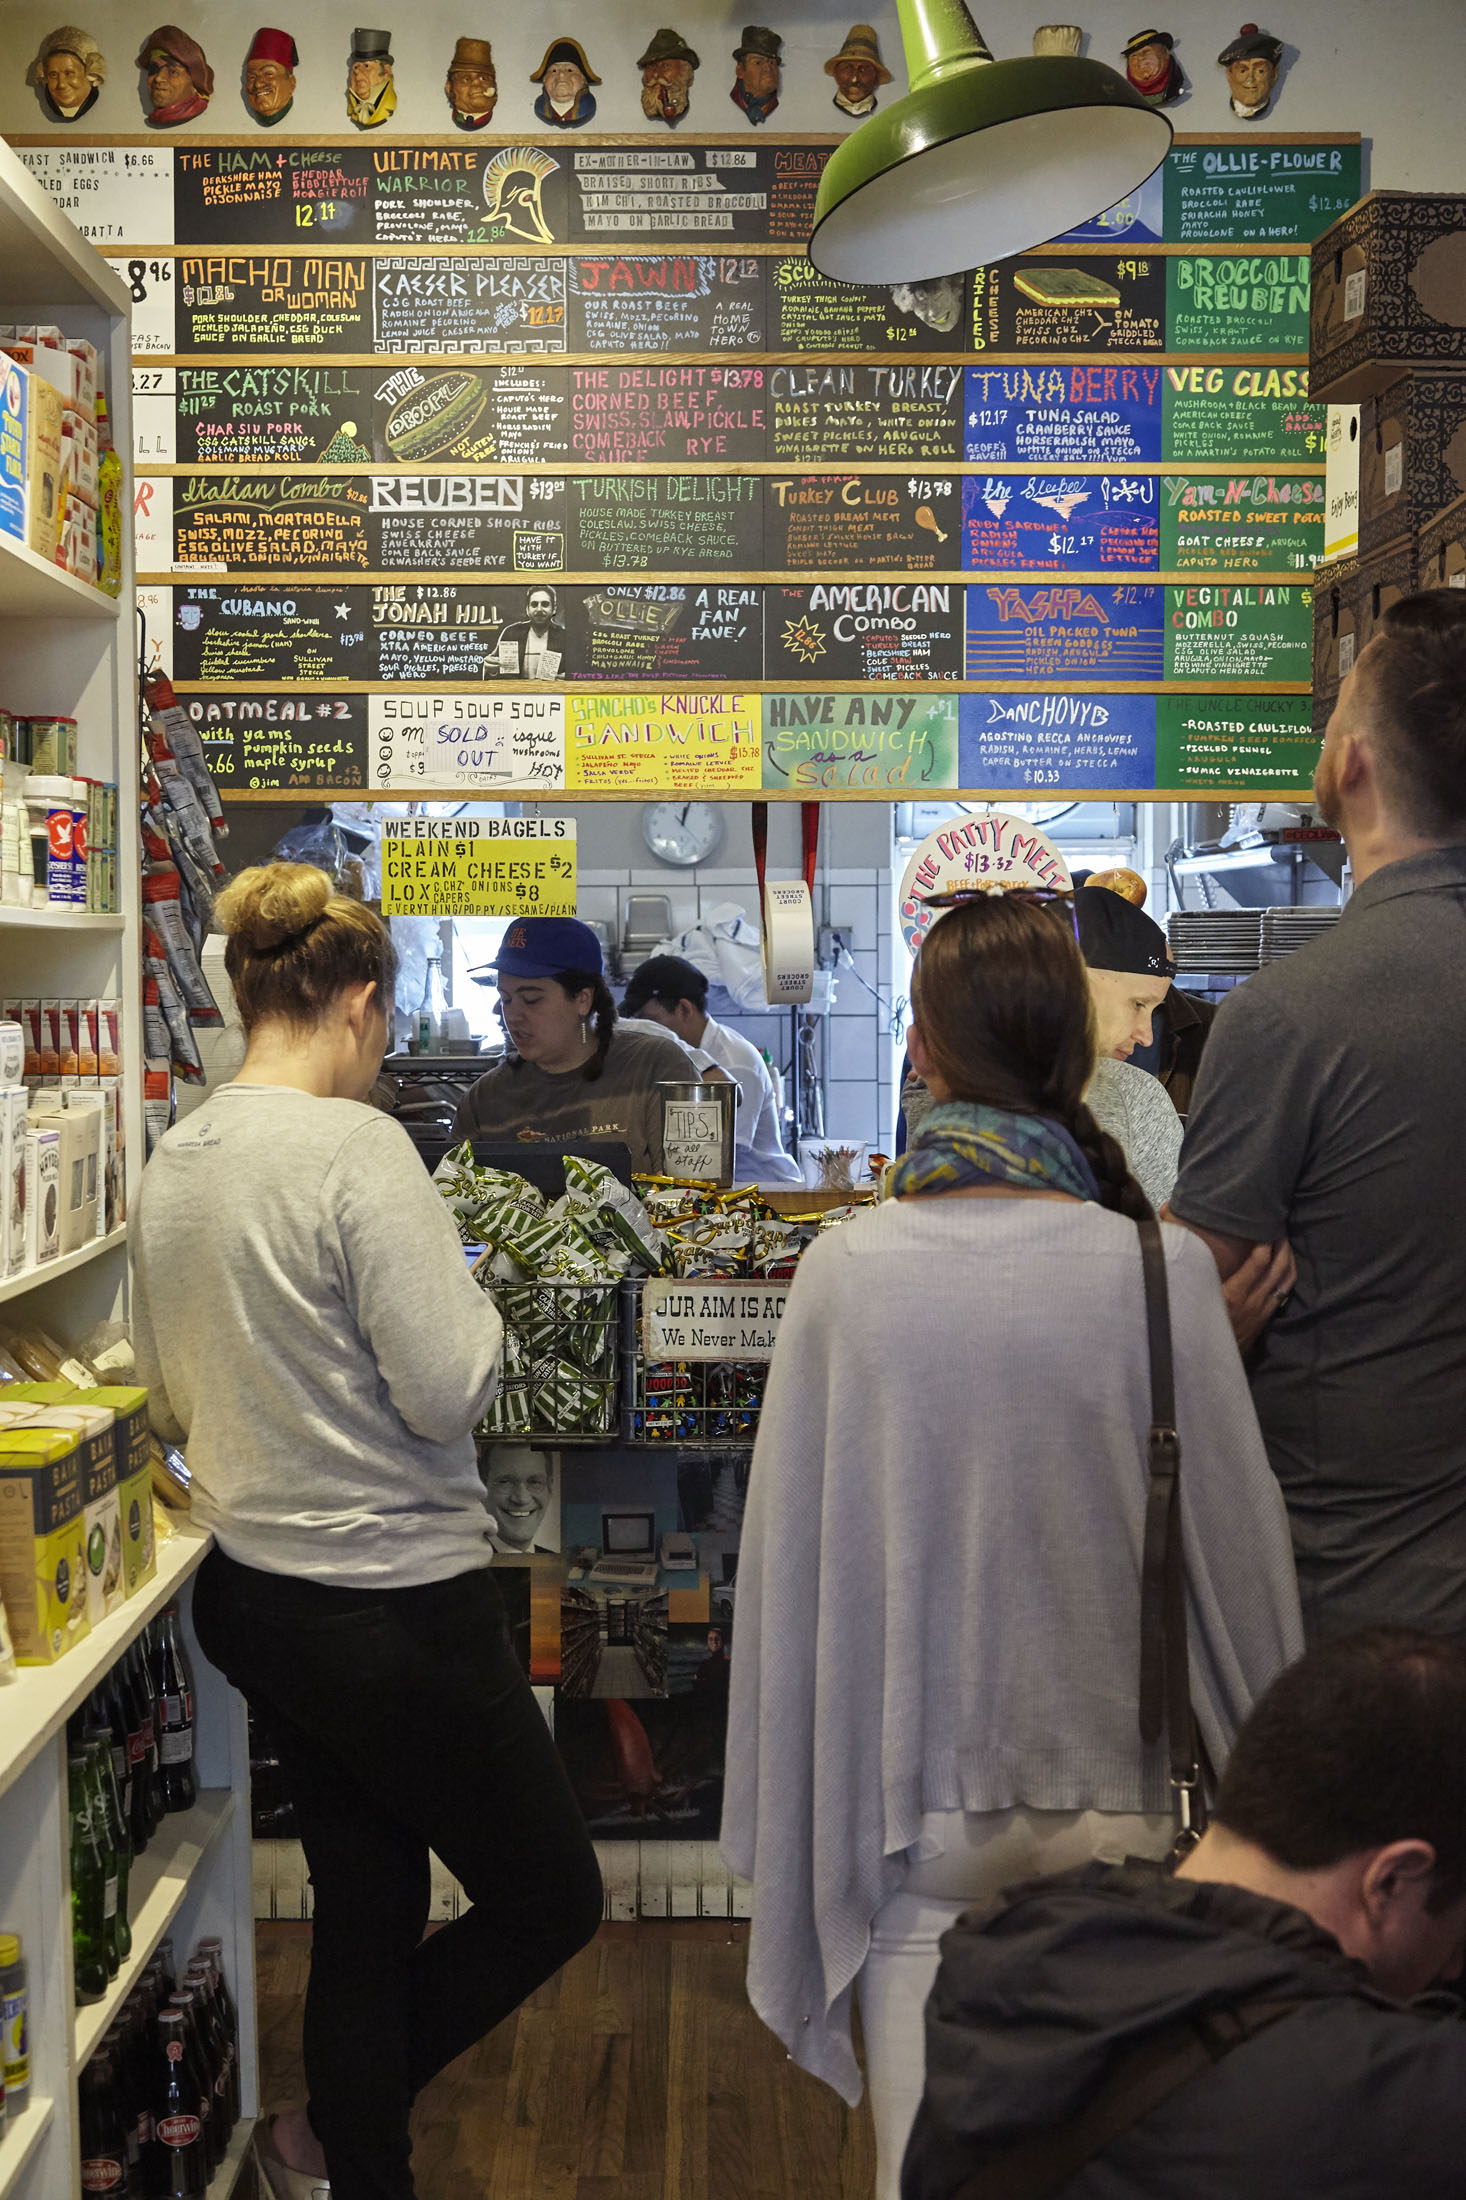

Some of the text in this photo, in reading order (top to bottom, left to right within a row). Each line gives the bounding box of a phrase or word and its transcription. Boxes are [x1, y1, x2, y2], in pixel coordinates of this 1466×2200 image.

[60, 152, 115, 166] SANDWICH
[125, 153, 153, 168] $6.66
[180, 151, 343, 172] THE HAM CHEESE
[373, 150, 478, 172] ULTIMATE
[579, 154, 747, 168] EX-MOTHER-IN-LAW $12.86
[774, 151, 830, 171] MEAT
[1170, 151, 1343, 173] THE OLLIE-FLOWER
[74, 178, 99, 190] EGGS
[376, 176, 471, 193] WARRIOR
[583, 176, 713, 190] BRAISED SHORT RIBS
[1181, 184, 1296, 196] ROASTED CAULIFLOWER
[587, 214, 728, 228] MAYO ON GARLIC BREAD
[182, 258, 366, 290] MACHO MAN
[580, 260, 696, 292] JAWN
[378, 272, 564, 300] CAESER PLEASER
[1178, 256, 1310, 314] BROCCOLI REUBEN
[261, 288, 357, 310] OR WOMAN
[584, 301, 688, 310] OUR ROAST BEEF
[989, 269, 999, 342] CHEESE
[1016, 308, 1093, 317] AMERICAN CHZ
[573, 368, 763, 389] THE DELIGHT $13.78
[770, 366, 962, 404] CLEAN TURKEY
[1167, 367, 1223, 393] VEG
[232, 401, 332, 417] ROAST PORK
[572, 393, 650, 411] CORNED
[776, 402, 819, 413] ROAST
[824, 402, 880, 412] TURKEY
[968, 410, 1008, 427] $12.17
[1026, 410, 1120, 424] TUNA SALAD
[1016, 424, 1131, 435] CRANBERRY SAUCE
[181, 477, 353, 502] Italian Combo
[371, 477, 522, 507] REUBEN
[573, 476, 760, 502] TURKISH DELIGHT
[1331, 491, 1357, 518] Enjoy Being
[382, 518, 561, 530] HOUSE CORNED SHORT RIBS
[1178, 510, 1241, 523] ROASTED
[1247, 512, 1287, 523] SWEET
[603, 554, 648, 568] $13.78
[372, 586, 456, 602] THE $12.86
[607, 586, 686, 601] ONLY $12.86
[695, 589, 759, 608] A REAL
[810, 585, 949, 613] AMERICAN
[1173, 588, 1290, 608] VEGITALIAN
[220, 600, 297, 616] CUBANO
[372, 603, 503, 624] JONAH HILL
[700, 609, 740, 625] FAN
[1172, 610, 1238, 628] COMBO
[380, 632, 478, 642] CORNED BEEF
[1025, 627, 1138, 637] OIL PACKED TUNA
[1240, 633, 1284, 641] SQUASH
[189, 700, 352, 722] OATMEAL #2
[384, 700, 560, 718] SOUP SOUP SOUP
[661, 694, 746, 714] KNUCKLE
[770, 696, 917, 729] HAVE ANY
[199, 728, 292, 742] with yams
[436, 725, 489, 744] SOLD
[576, 718, 754, 748] SANDWICH
[776, 730, 927, 754] SANDWICH
[457, 750, 498, 767] OUT
[1024, 769, 1060, 784] $10.33
[386, 820, 566, 838] WEEKEND BAGELS
[388, 841, 474, 858] PLAIN $1
[936, 818, 1009, 861] PATTY
[1011, 834, 1067, 889] MELT
[388, 854, 573, 879] CREAM CHEESE $2
[390, 881, 539, 901] LOX ONIONS $8
[433, 892, 470, 904] CAPERS
[592, 1123, 619, 1132] PARK
[675, 1154, 713, 1174] staff
[700, 1296, 735, 1318] AIM
[741, 1297, 759, 1318] IS
[662, 1328, 685, 1346] We
[692, 1329, 736, 1347] Never
